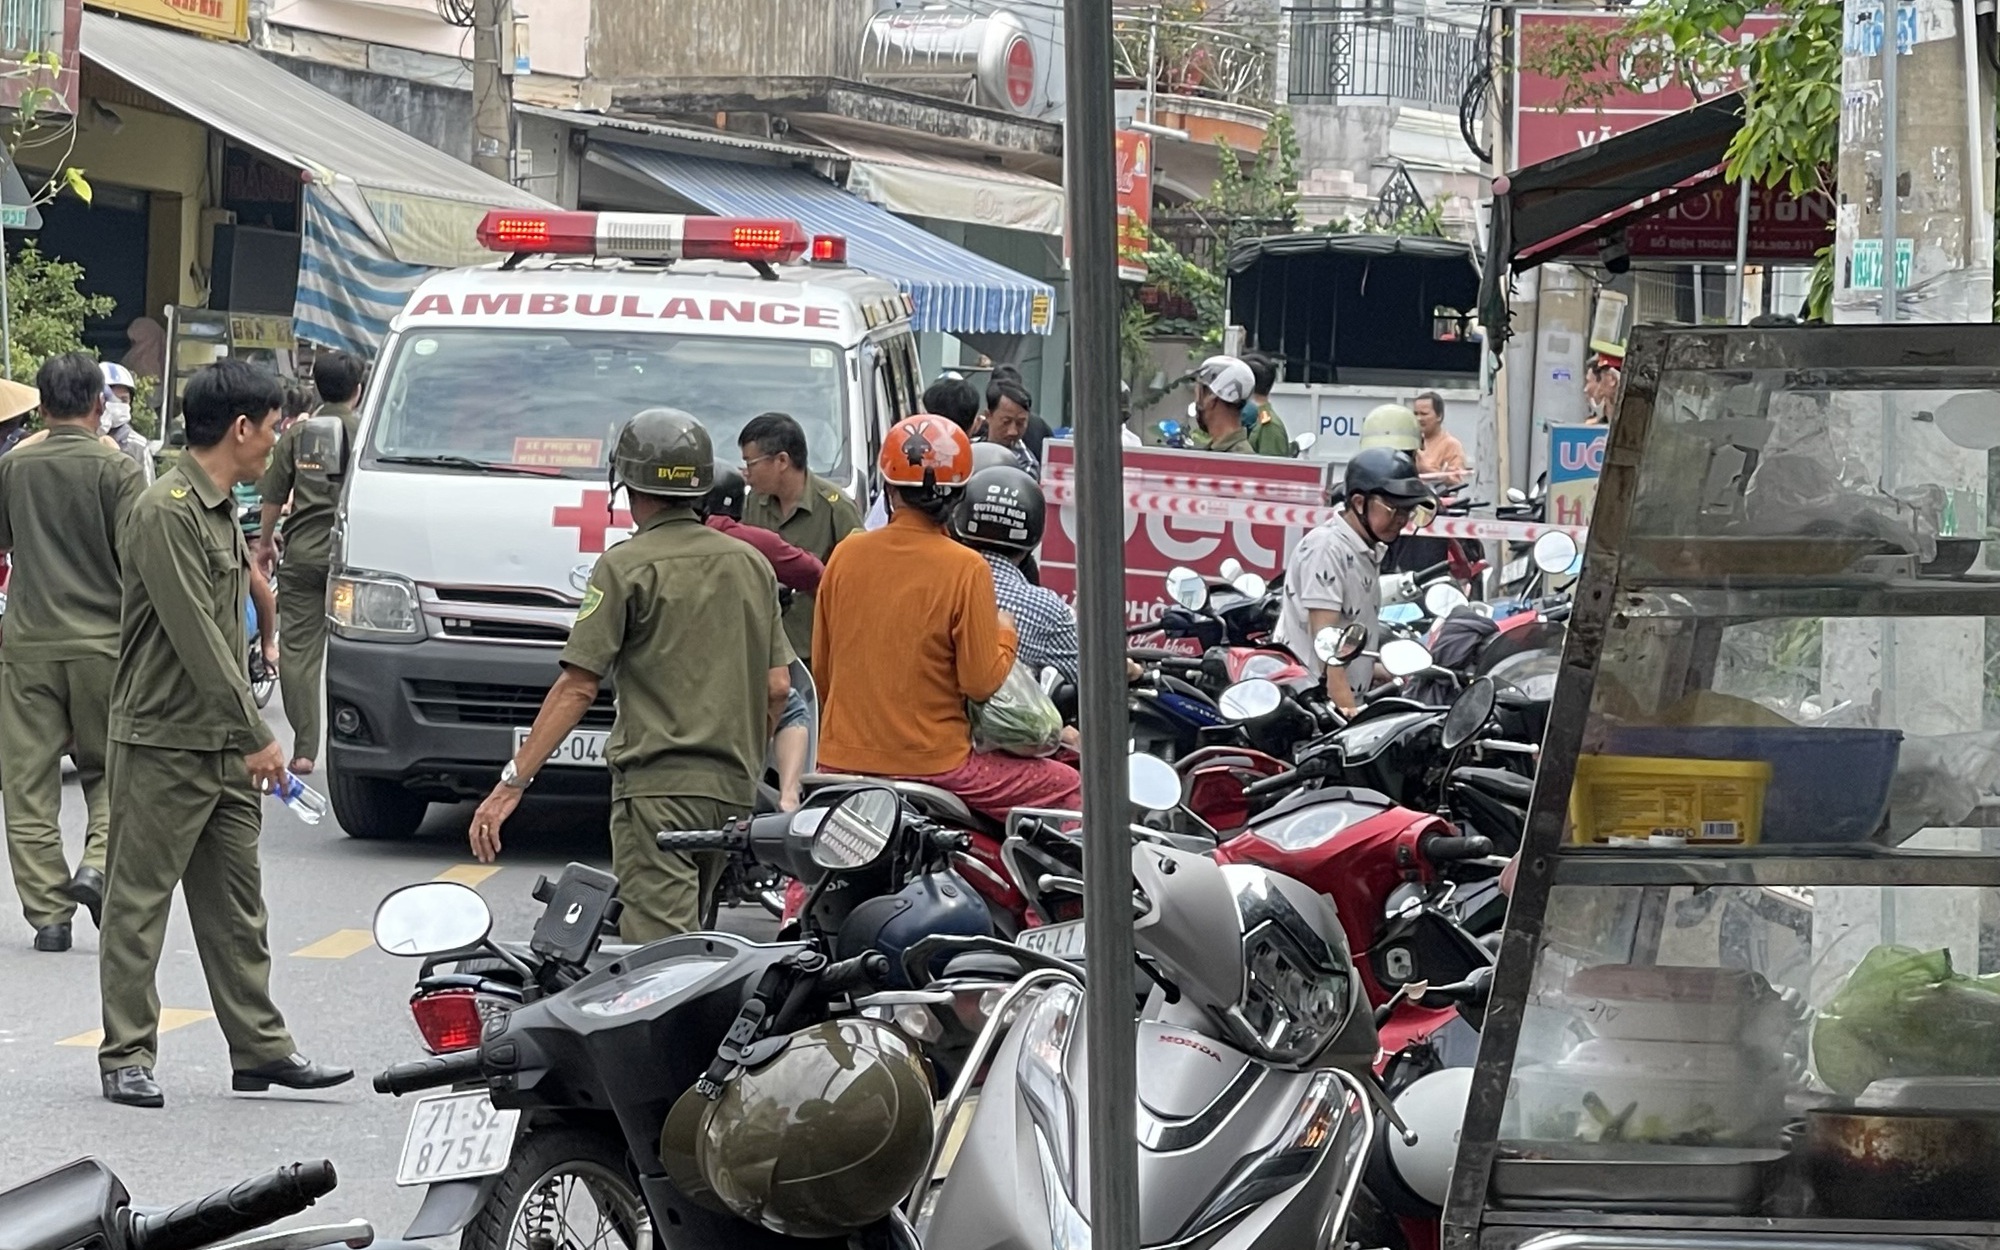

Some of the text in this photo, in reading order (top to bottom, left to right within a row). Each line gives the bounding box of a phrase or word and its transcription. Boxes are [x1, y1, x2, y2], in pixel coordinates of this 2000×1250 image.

[408, 294, 840, 330] AMBULANCE
[1320, 416, 1366, 436] POL
[1160, 1034, 1222, 1063] HONDA
